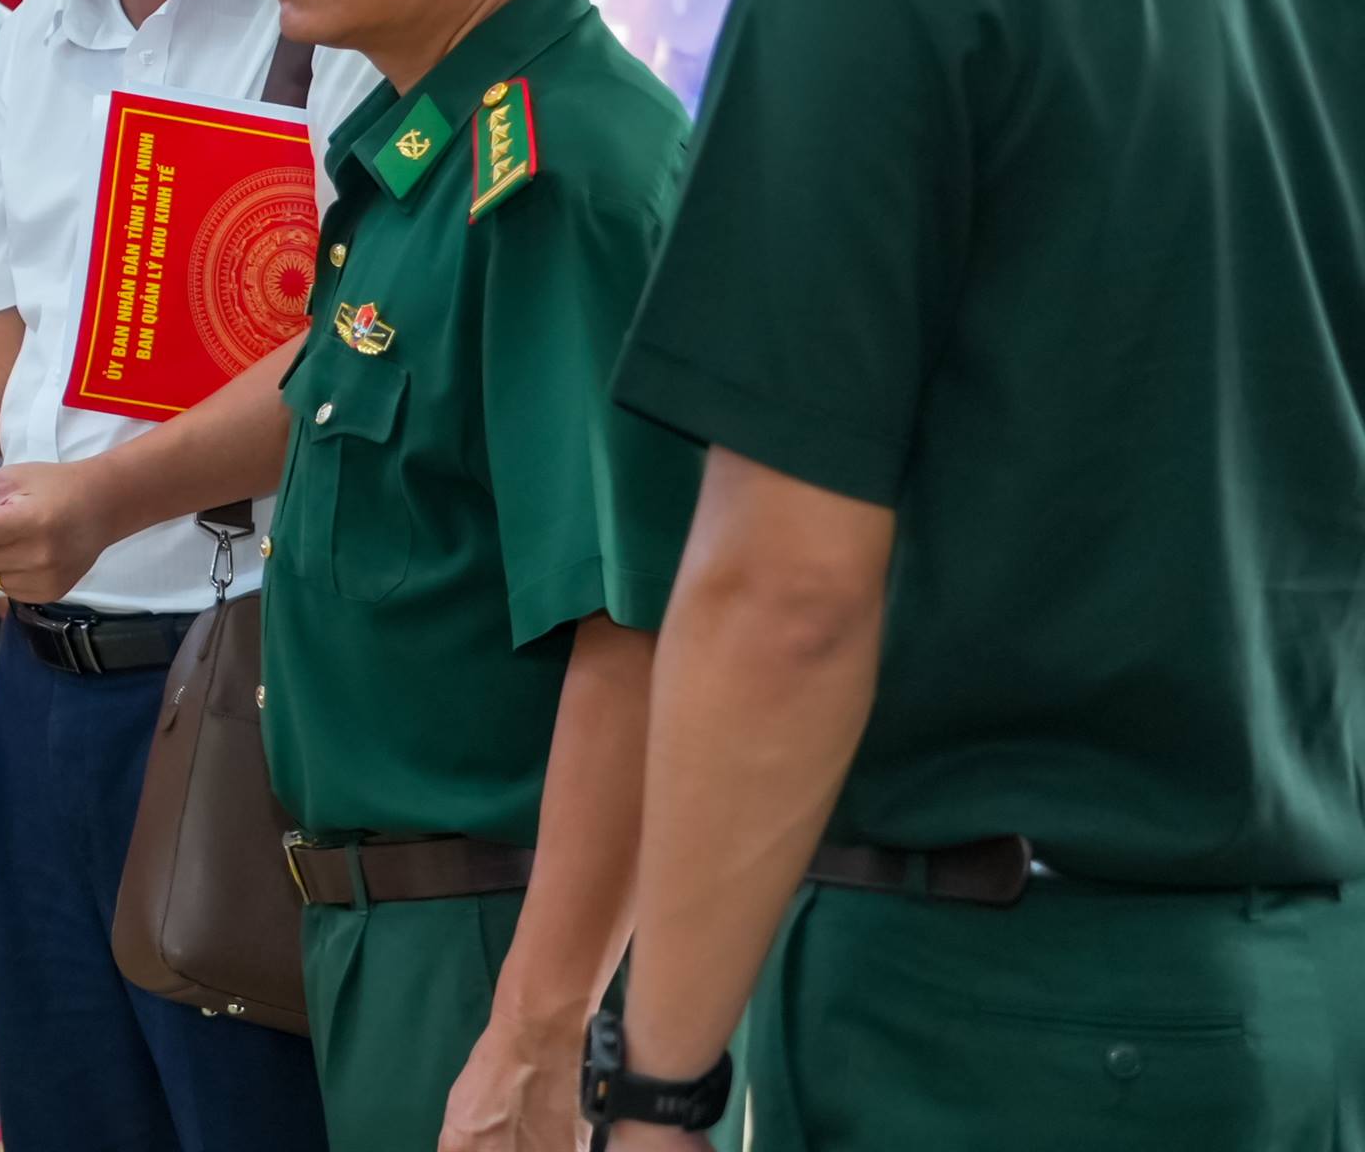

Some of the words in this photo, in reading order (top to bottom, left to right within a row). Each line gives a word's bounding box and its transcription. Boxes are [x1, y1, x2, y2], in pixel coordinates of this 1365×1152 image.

[136, 132, 154, 170] NINH
[131, 173, 149, 201] TÂY
[156, 163, 175, 182] TẾ
[154, 186, 172, 224] KINH
[124, 205, 146, 239] TỈNH
[150, 227, 168, 258] KHU
[122, 243, 141, 276] DÂN
[145, 260, 163, 280] LÝ
[117, 279, 136, 322] NHÂN
[139, 282, 161, 324] QUẢN
[111, 325, 130, 358] BAN
[136, 328, 155, 360] BAN
[102, 360, 124, 381] ỦY
